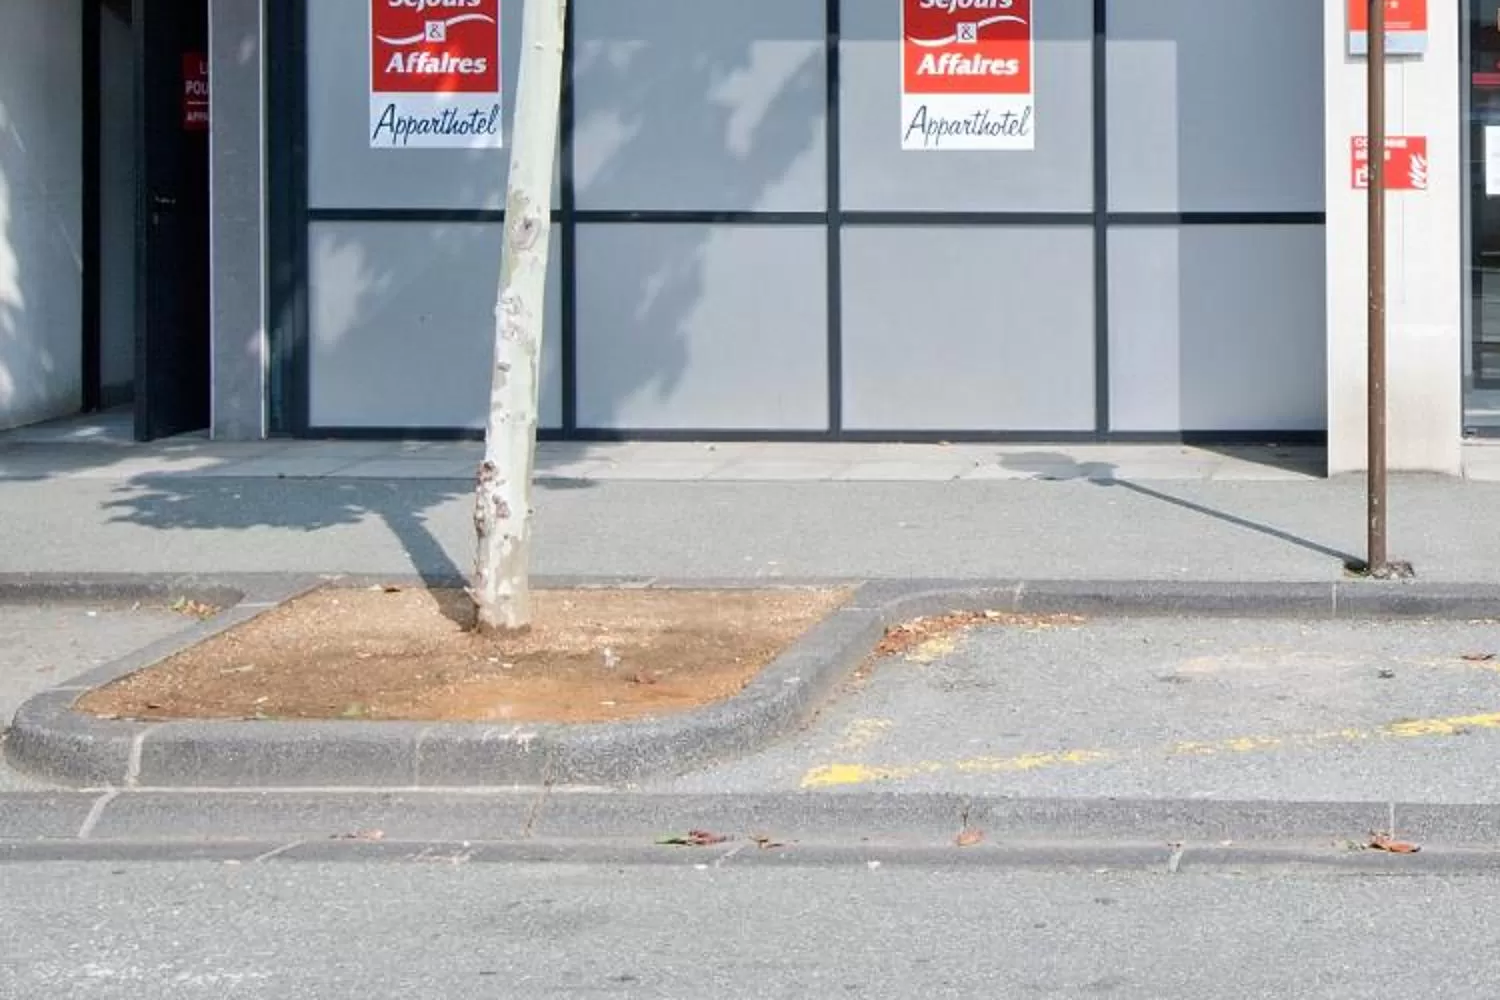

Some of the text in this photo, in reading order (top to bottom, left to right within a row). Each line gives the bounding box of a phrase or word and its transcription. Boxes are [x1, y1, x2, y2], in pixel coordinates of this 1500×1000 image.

[385, 52, 488, 74] Affaires
[916, 53, 1020, 76] Affaires
[373, 103, 500, 146] Apparthotel
[904, 103, 1032, 147] Apparthotel
